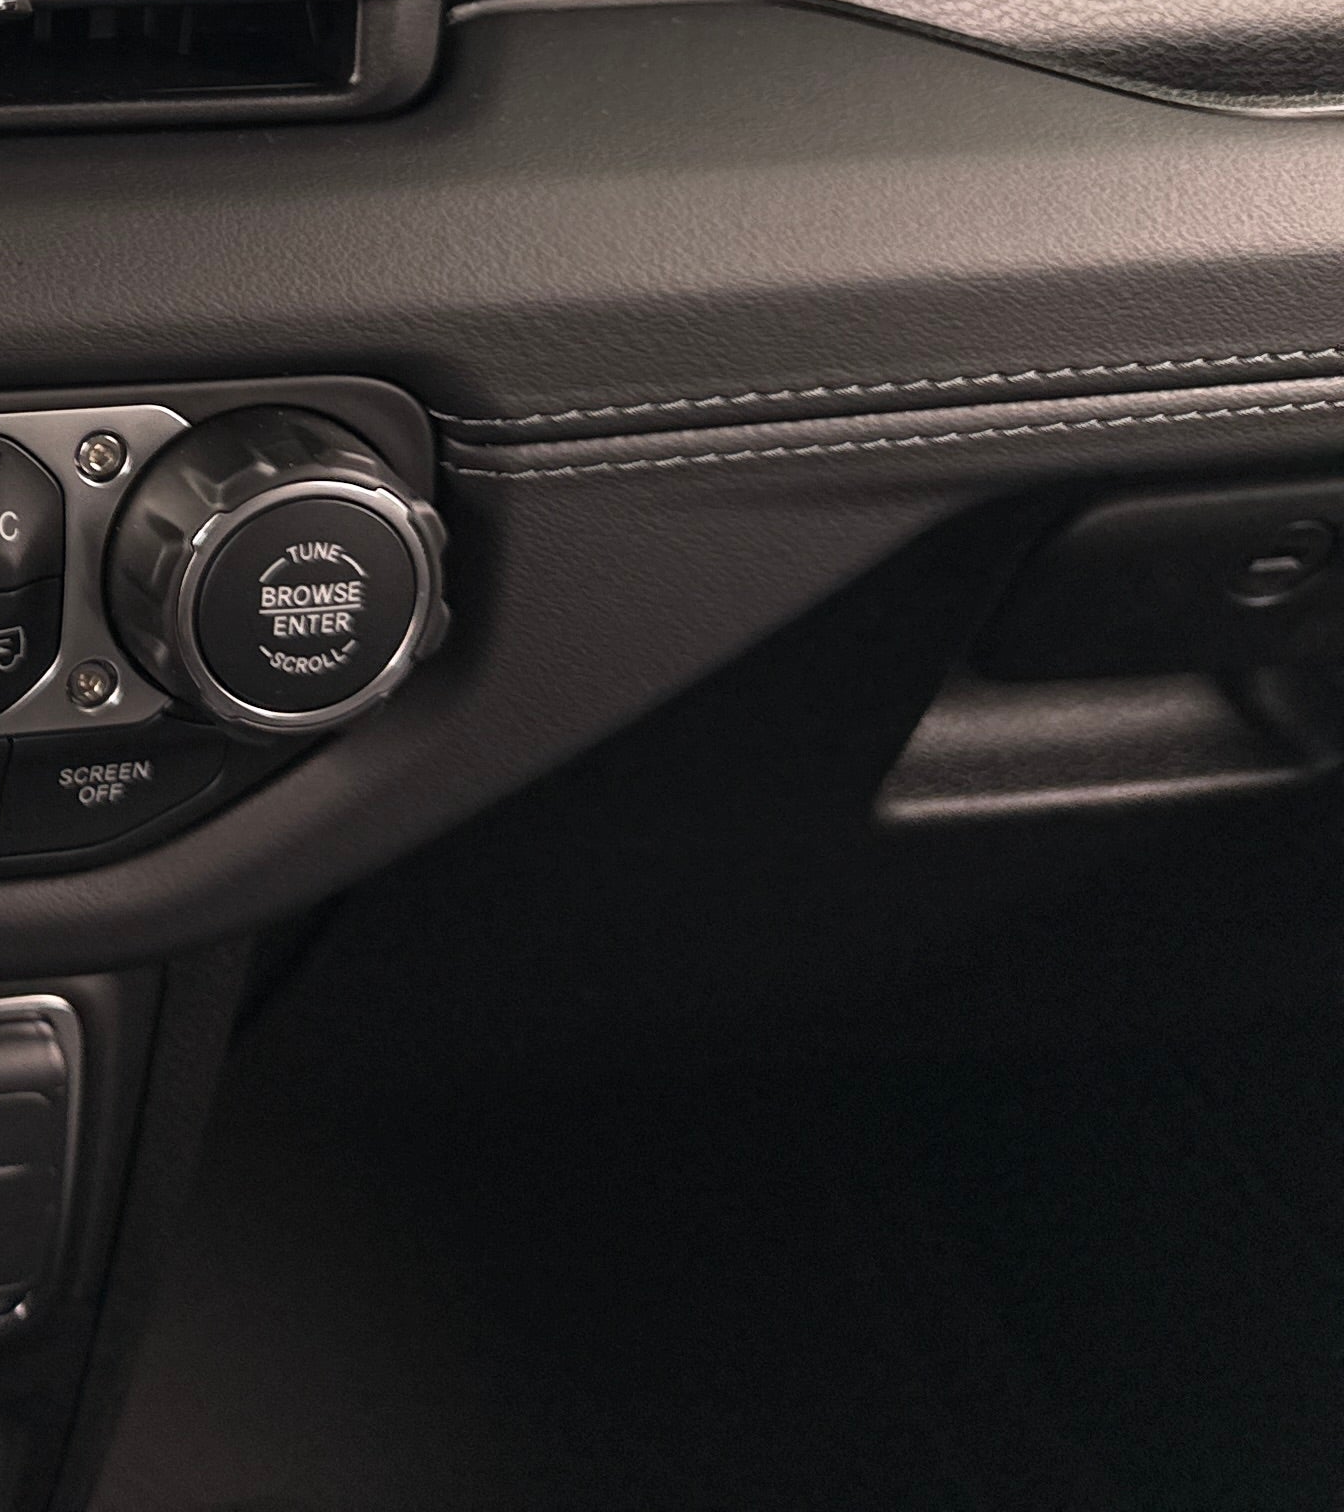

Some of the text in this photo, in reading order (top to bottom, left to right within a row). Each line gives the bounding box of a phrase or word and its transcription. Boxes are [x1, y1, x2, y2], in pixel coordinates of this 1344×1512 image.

[286, 541, 345, 565] TUNE
[261, 581, 362, 608] BROWSE
[272, 611, 353, 638] ENTER
[268, 648, 347, 675] SCROLL
[59, 760, 153, 786] SCREEN
[78, 783, 126, 807] OFF
